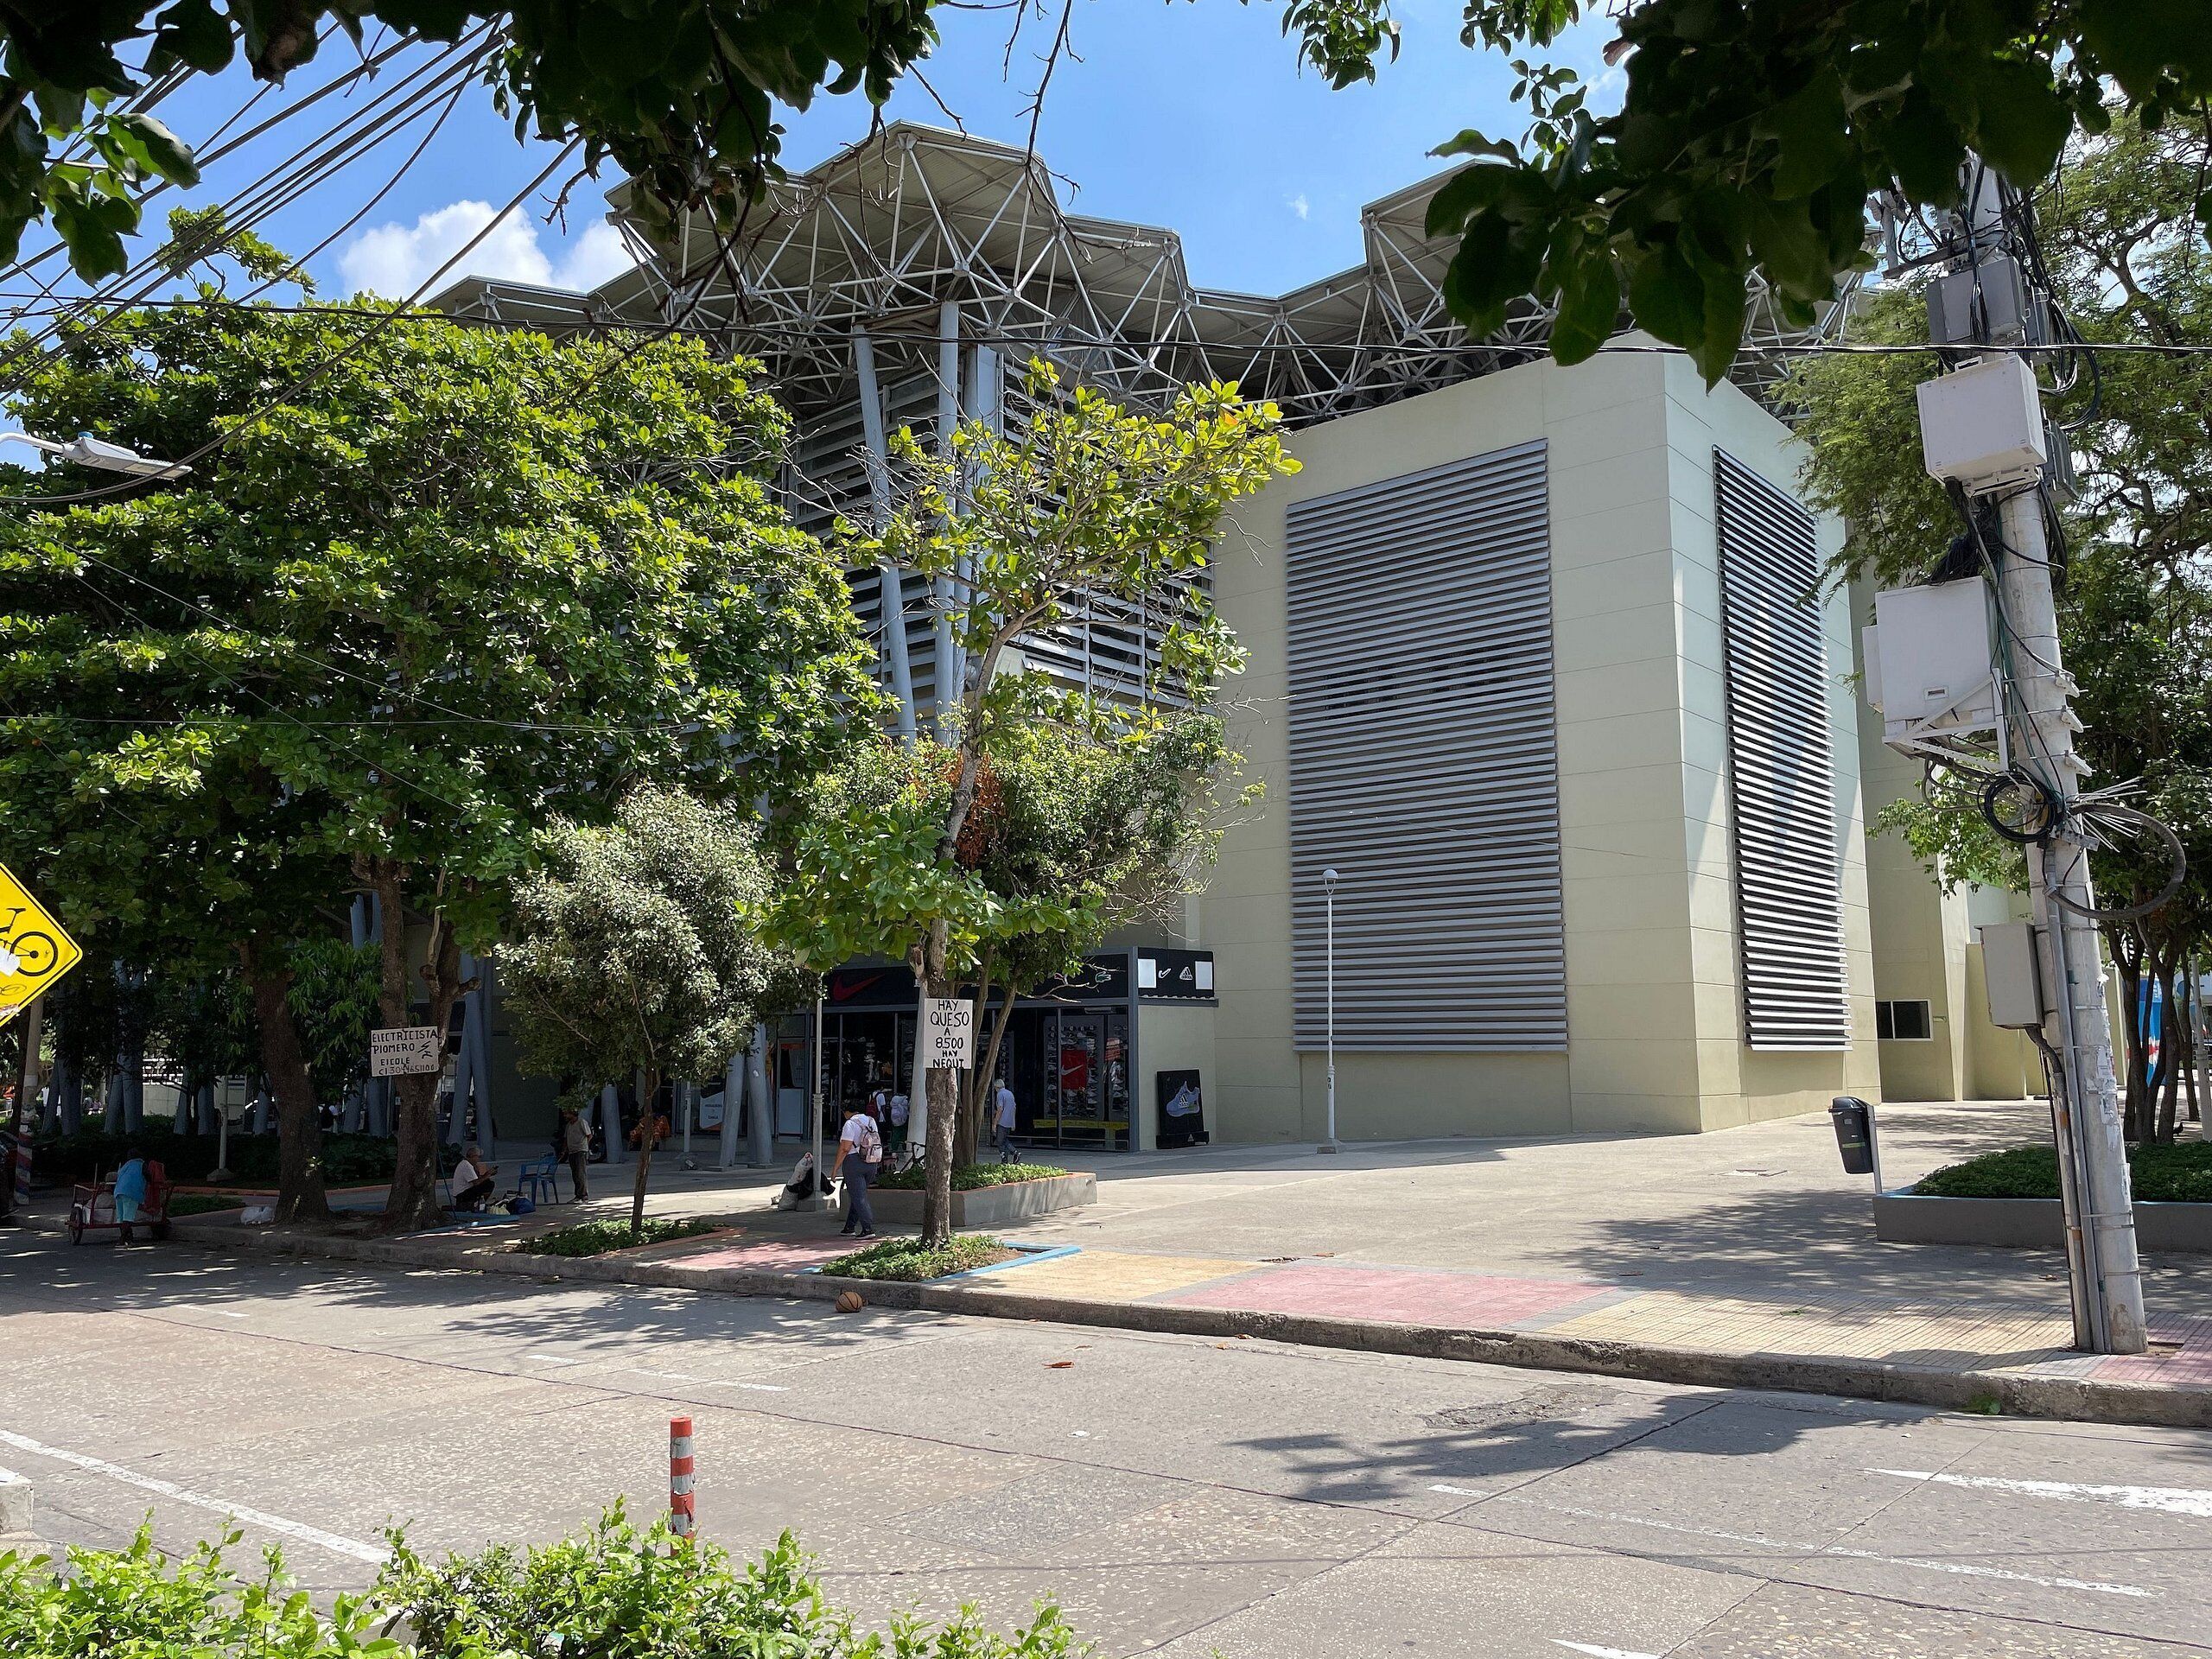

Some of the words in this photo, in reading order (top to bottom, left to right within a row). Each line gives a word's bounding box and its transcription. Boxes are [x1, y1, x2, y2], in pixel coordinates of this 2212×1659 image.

[938, 1000, 958, 1011] HAY
[930, 1011, 969, 1027] QUESO
[944, 1027, 950, 1036] A
